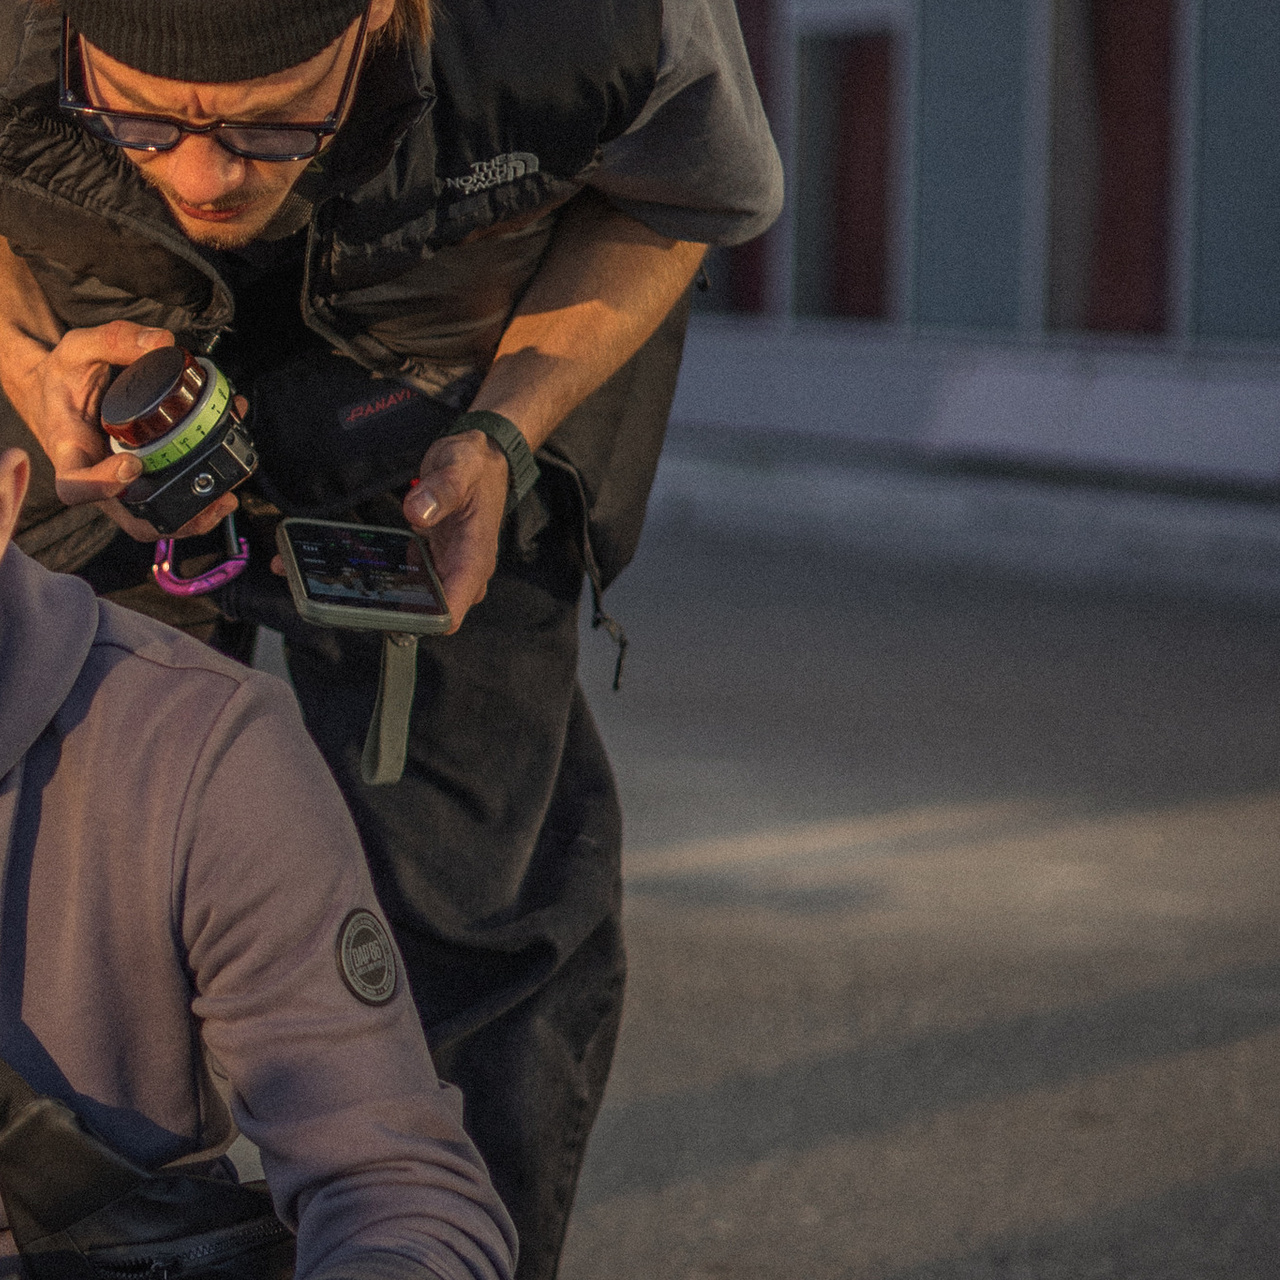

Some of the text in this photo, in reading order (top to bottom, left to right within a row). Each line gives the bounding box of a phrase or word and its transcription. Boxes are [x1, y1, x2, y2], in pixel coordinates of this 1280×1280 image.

[470, 153, 507, 173] THE
[444, 164, 507, 189] NORTH
[345, 388, 418, 422] PANAVI
